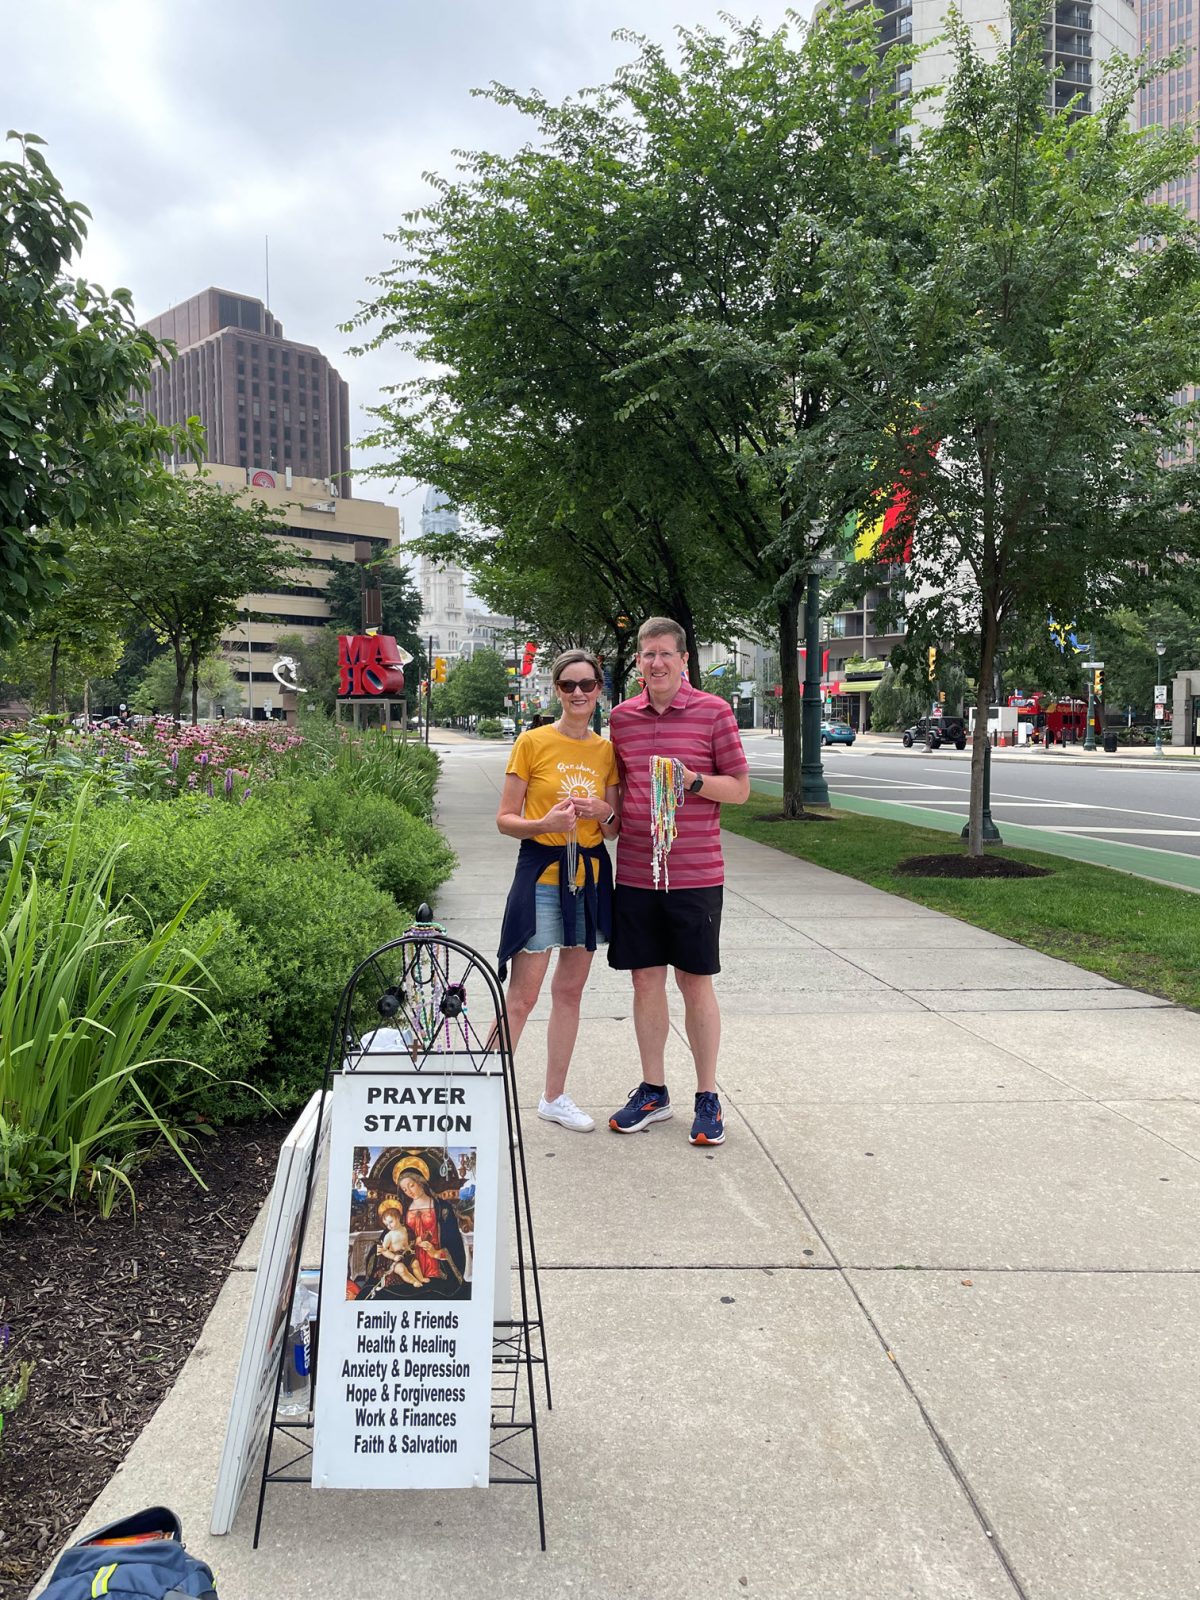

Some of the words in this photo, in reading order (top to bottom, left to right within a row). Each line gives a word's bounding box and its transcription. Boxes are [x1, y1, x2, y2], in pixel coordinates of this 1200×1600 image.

[367, 1087, 466, 1104] PRAYER
[364, 1115, 472, 1132] STATION
[357, 1311, 397, 1333] Family
[401, 1311, 410, 1329] &
[414, 1311, 459, 1329] Friends
[357, 1335, 396, 1353] Health
[400, 1335, 408, 1353] &
[412, 1335, 456, 1358] Healing
[341, 1359, 388, 1382] Anxiety
[391, 1359, 400, 1377] &
[404, 1359, 470, 1381] Depression
[346, 1384, 377, 1406] Hope
[381, 1384, 390, 1402] &
[394, 1384, 466, 1406] Forgiveness
[355, 1408, 386, 1427] Work
[389, 1408, 398, 1427] &
[402, 1408, 457, 1427] Finances
[354, 1435, 384, 1453] Faith
[388, 1435, 397, 1453] &
[401, 1435, 458, 1453] Salvation
